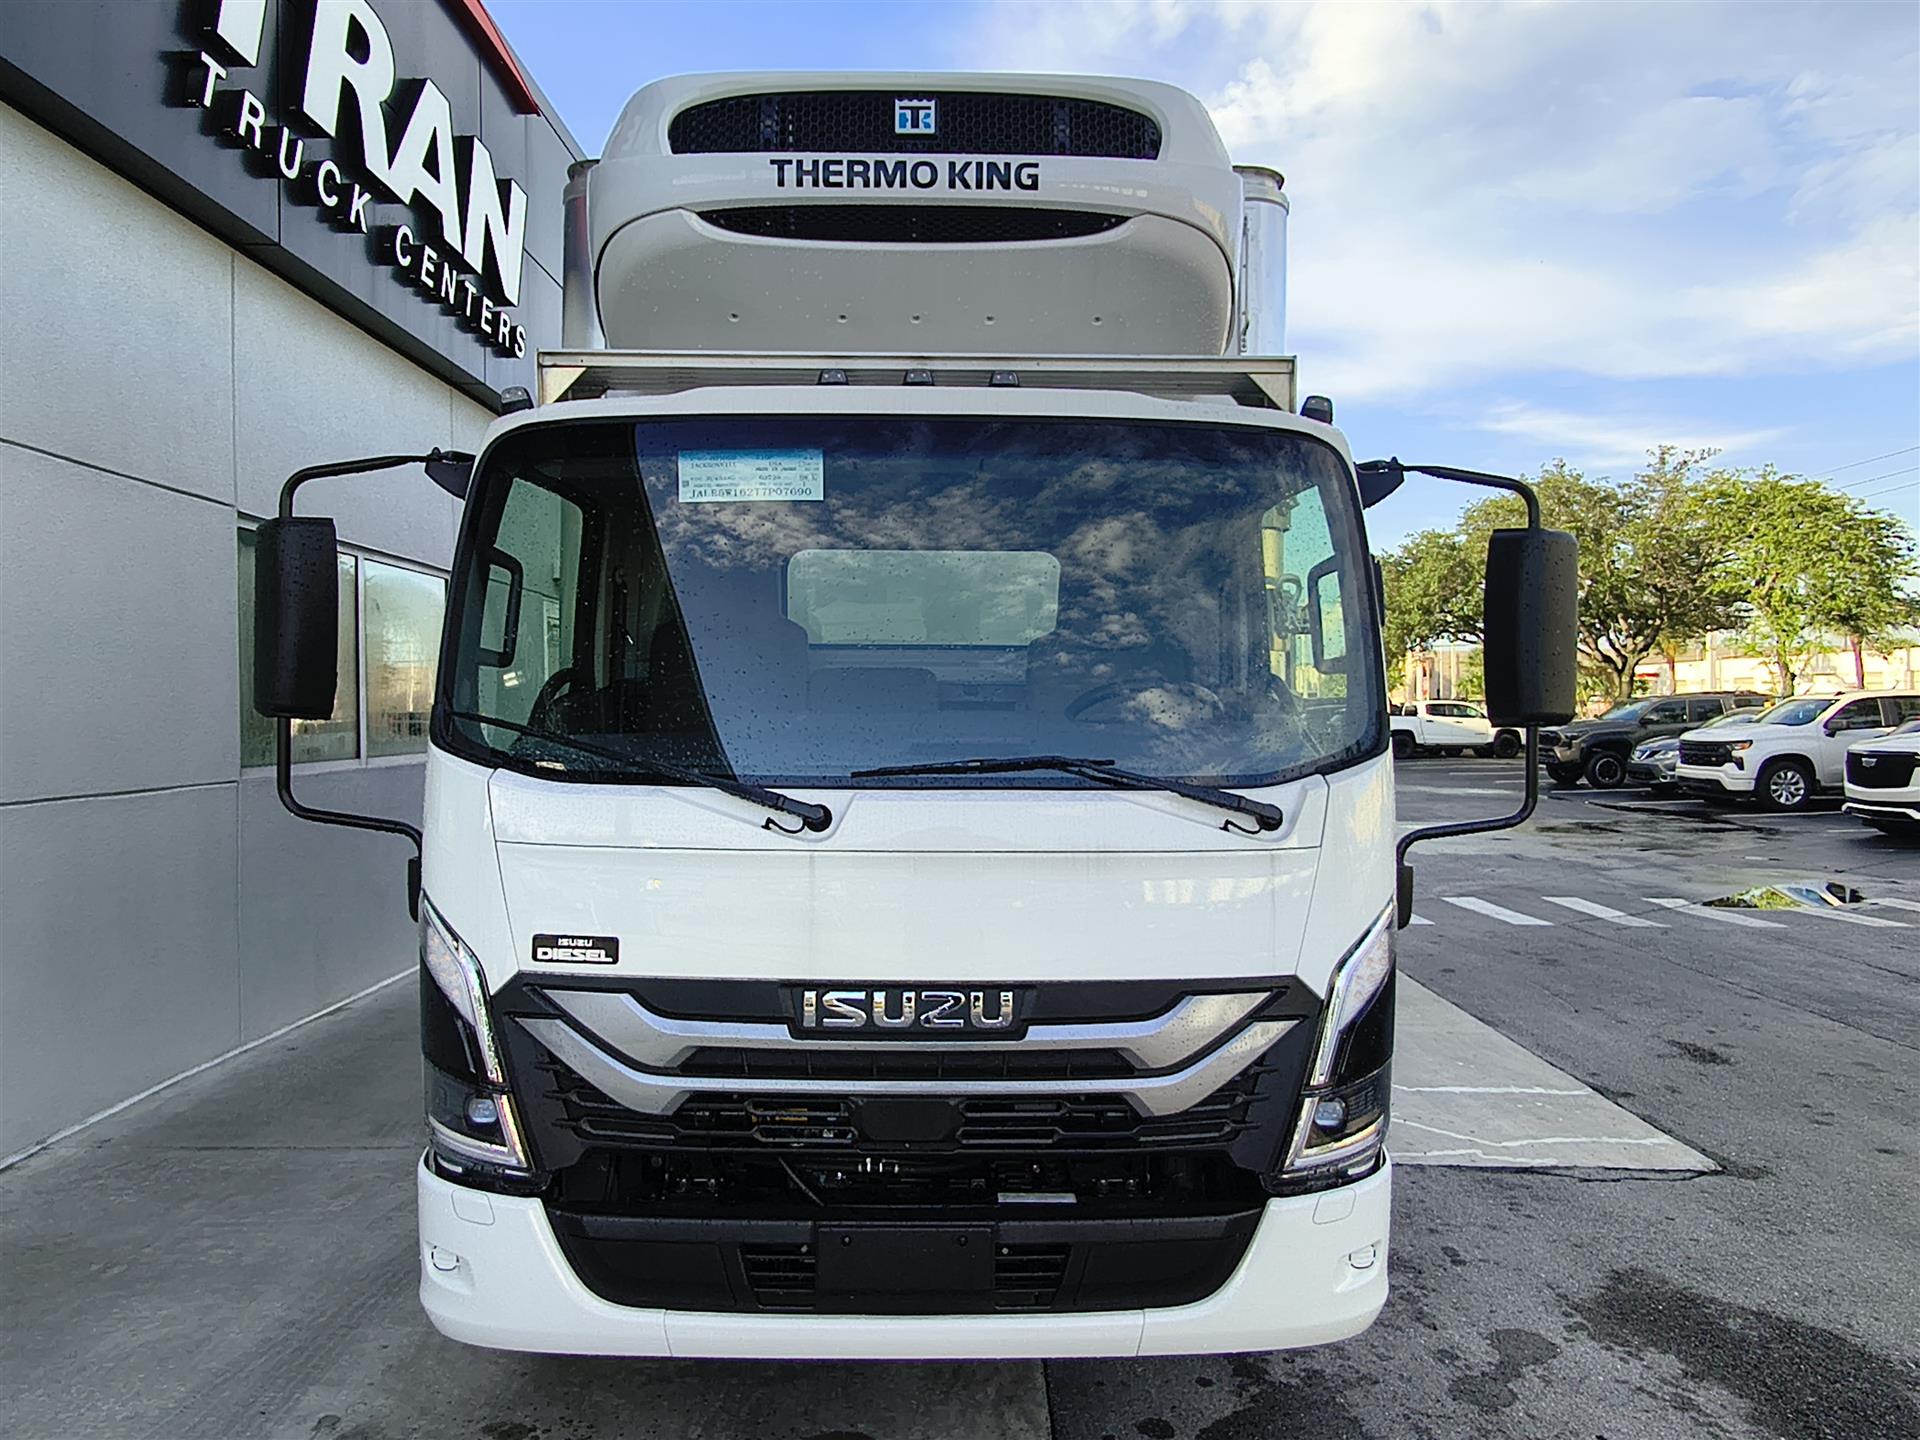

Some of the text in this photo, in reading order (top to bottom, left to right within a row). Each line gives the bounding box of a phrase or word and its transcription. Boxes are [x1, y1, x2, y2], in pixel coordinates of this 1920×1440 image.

[770, 158, 1040, 192] THERMO KING
[200, 52, 527, 359] TRUCK CENTERS
[536, 947, 614, 962] DIESEL
[557, 938, 593, 947] ISUZU
[803, 990, 1014, 1028] ISUZU
